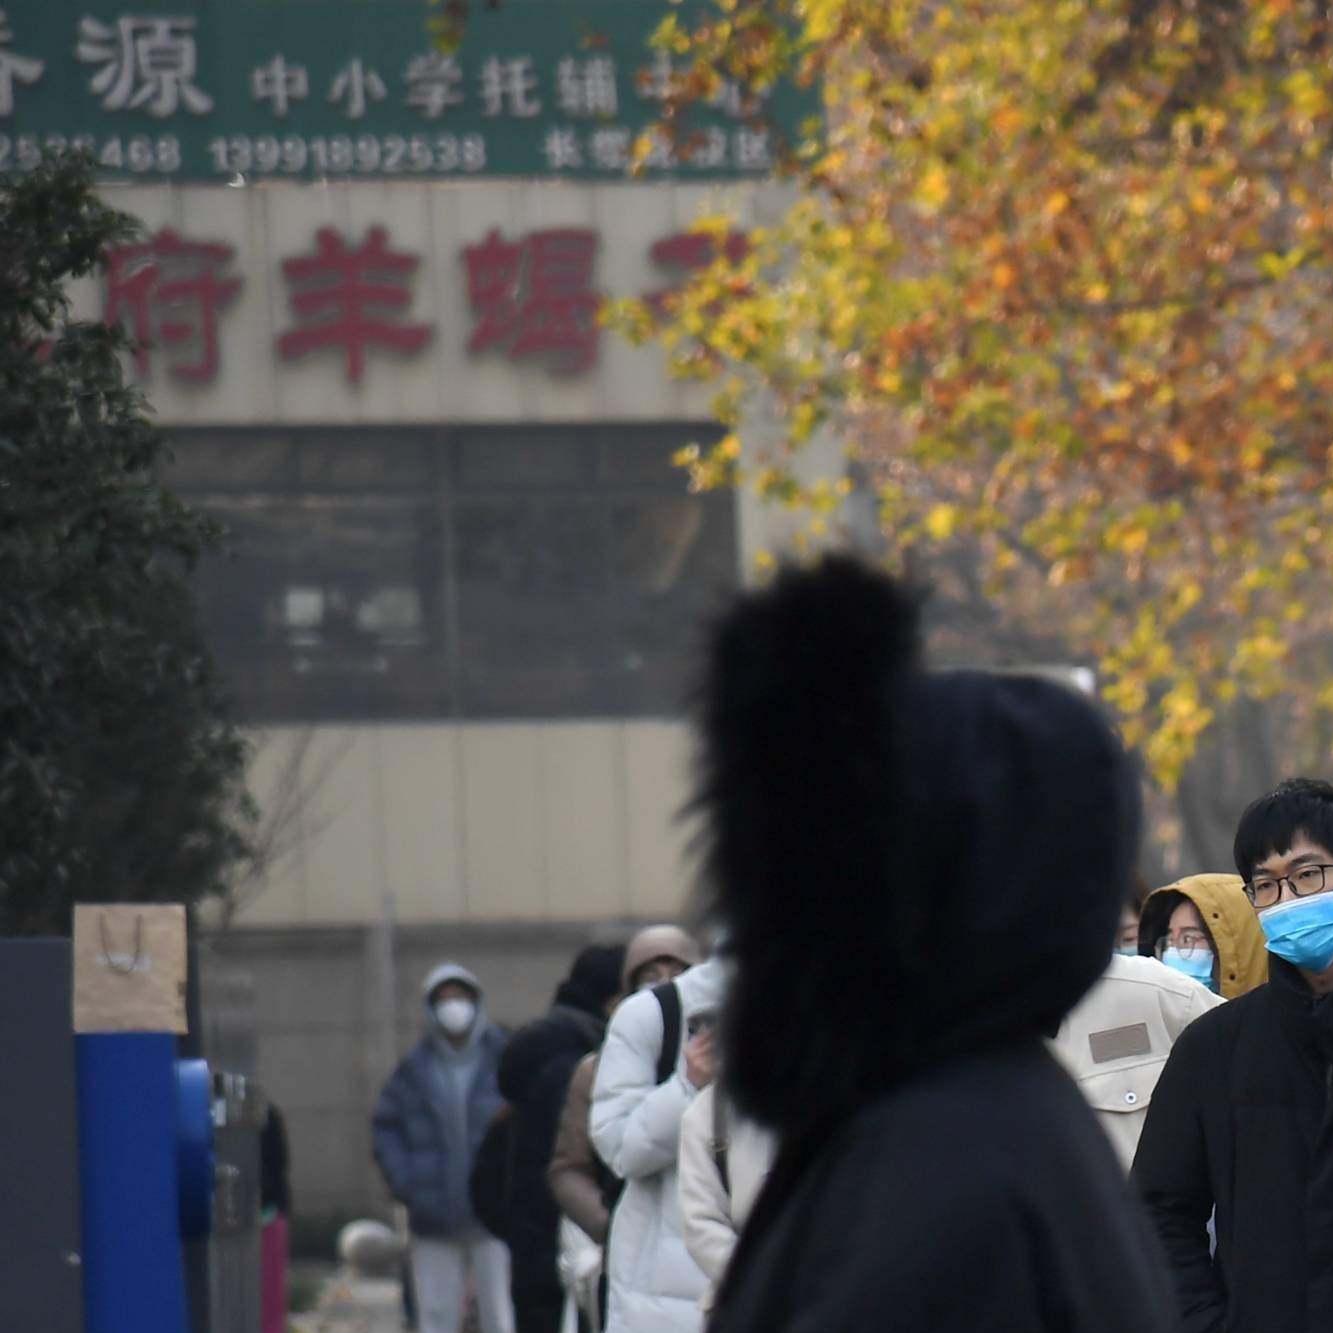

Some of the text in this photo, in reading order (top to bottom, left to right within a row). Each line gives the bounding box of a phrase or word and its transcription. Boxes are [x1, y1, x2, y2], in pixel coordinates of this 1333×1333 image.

[0, 8, 214, 118] 源
[25, 225, 757, 387] 府羊蝎
